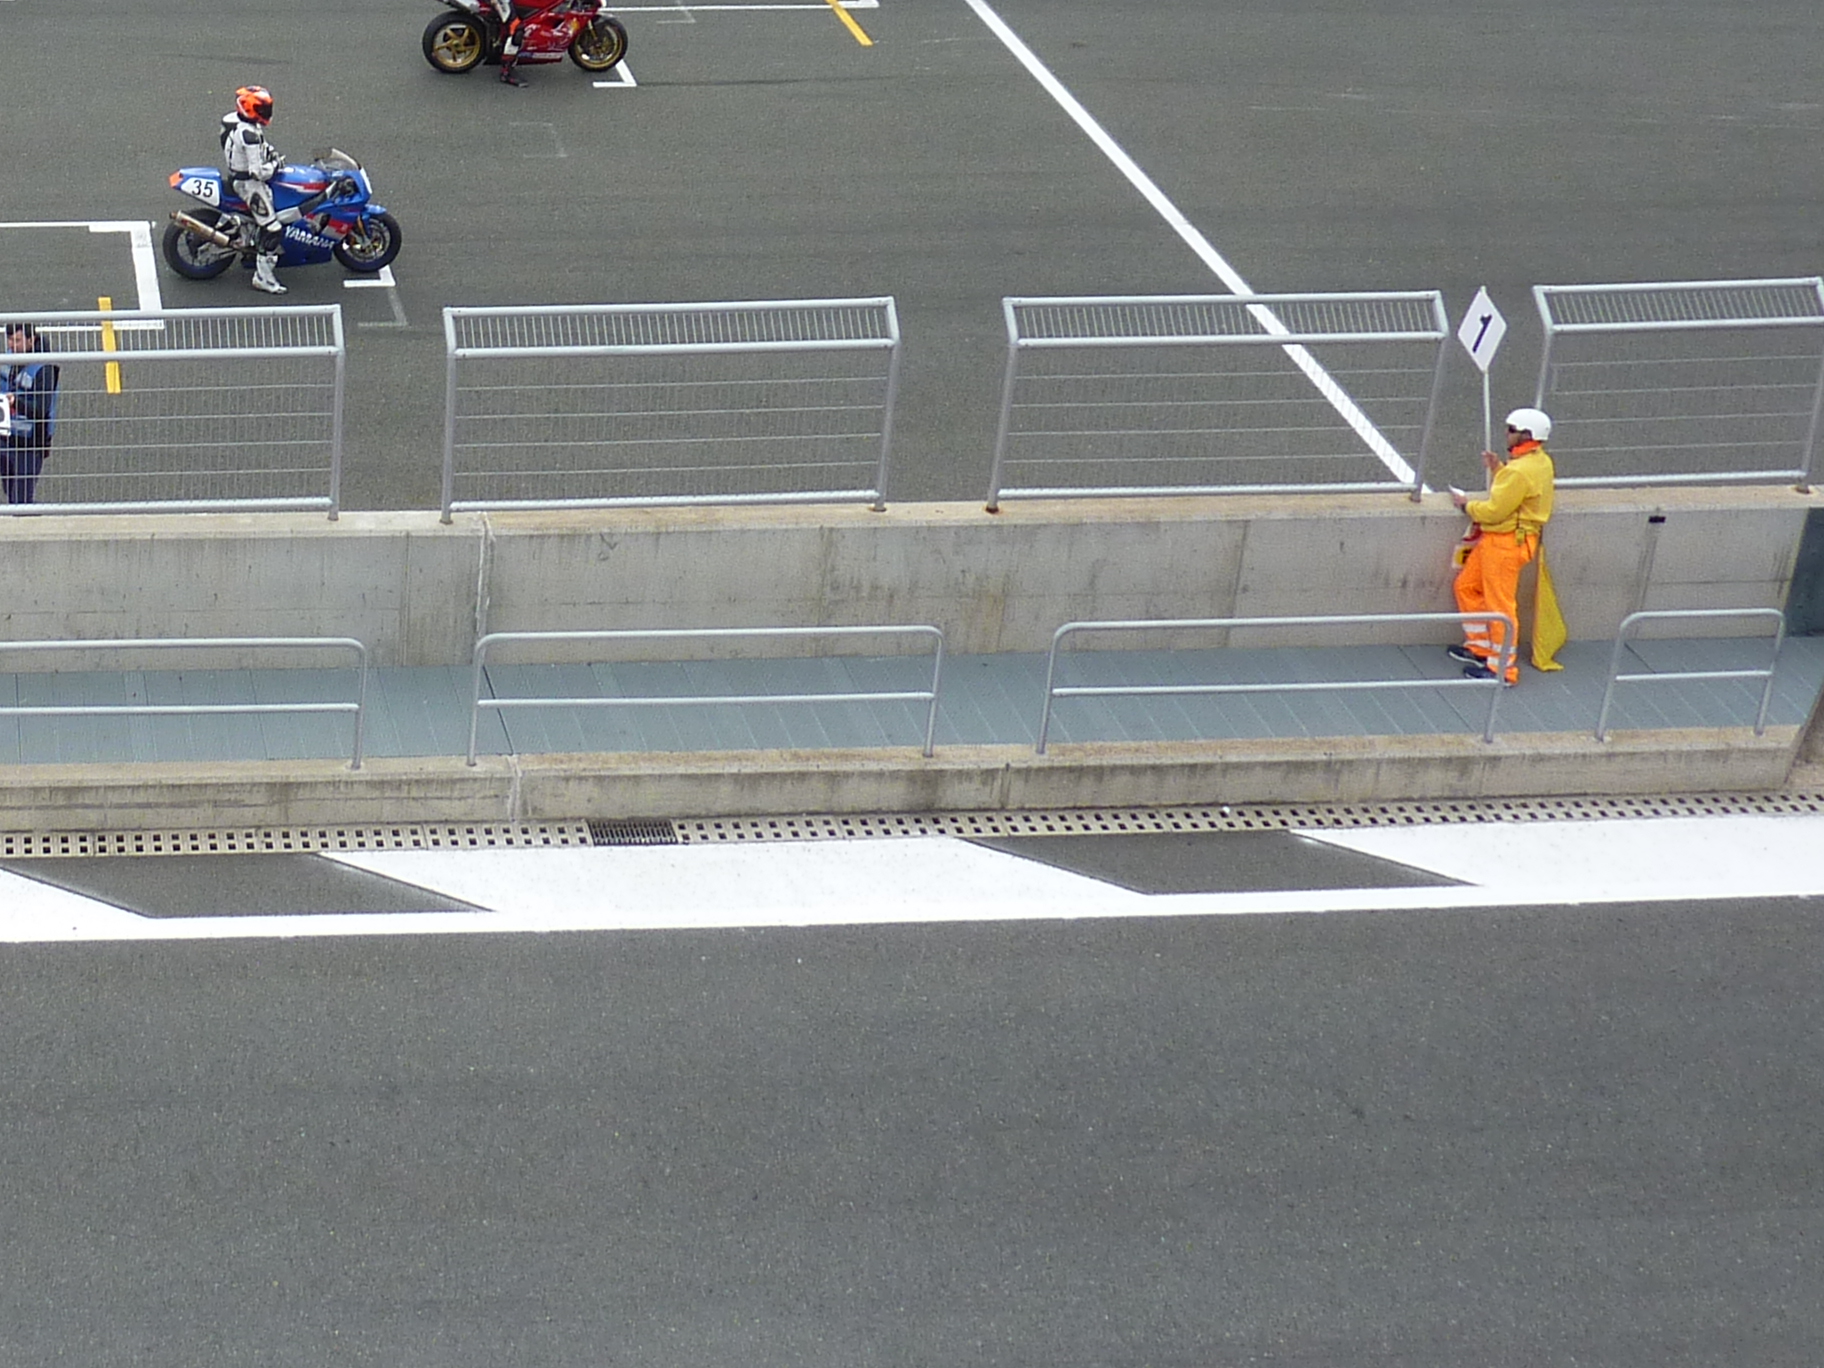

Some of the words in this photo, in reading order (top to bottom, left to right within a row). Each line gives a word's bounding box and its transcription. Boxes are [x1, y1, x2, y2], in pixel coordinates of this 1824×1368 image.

[191, 179, 214, 198] 35
[285, 224, 335, 250] YAMAHA
[1472, 314, 1493, 353] 1
